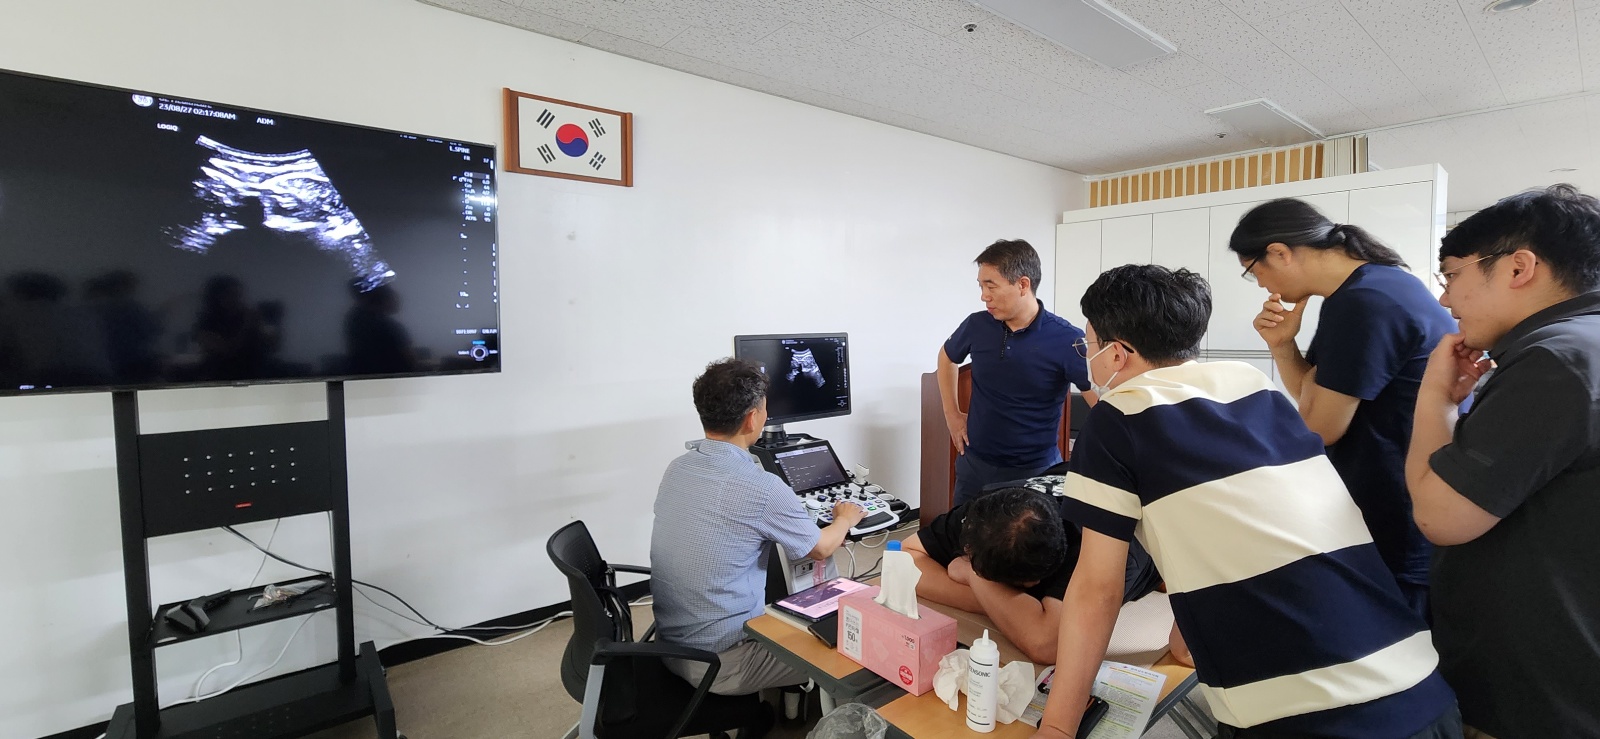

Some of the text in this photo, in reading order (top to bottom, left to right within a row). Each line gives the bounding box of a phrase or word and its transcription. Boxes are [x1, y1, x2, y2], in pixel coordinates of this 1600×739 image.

[158, 102, 192, 114] 23/08/27
[256, 117, 274, 126] ADM
[157, 123, 179, 132] LOGIQ
